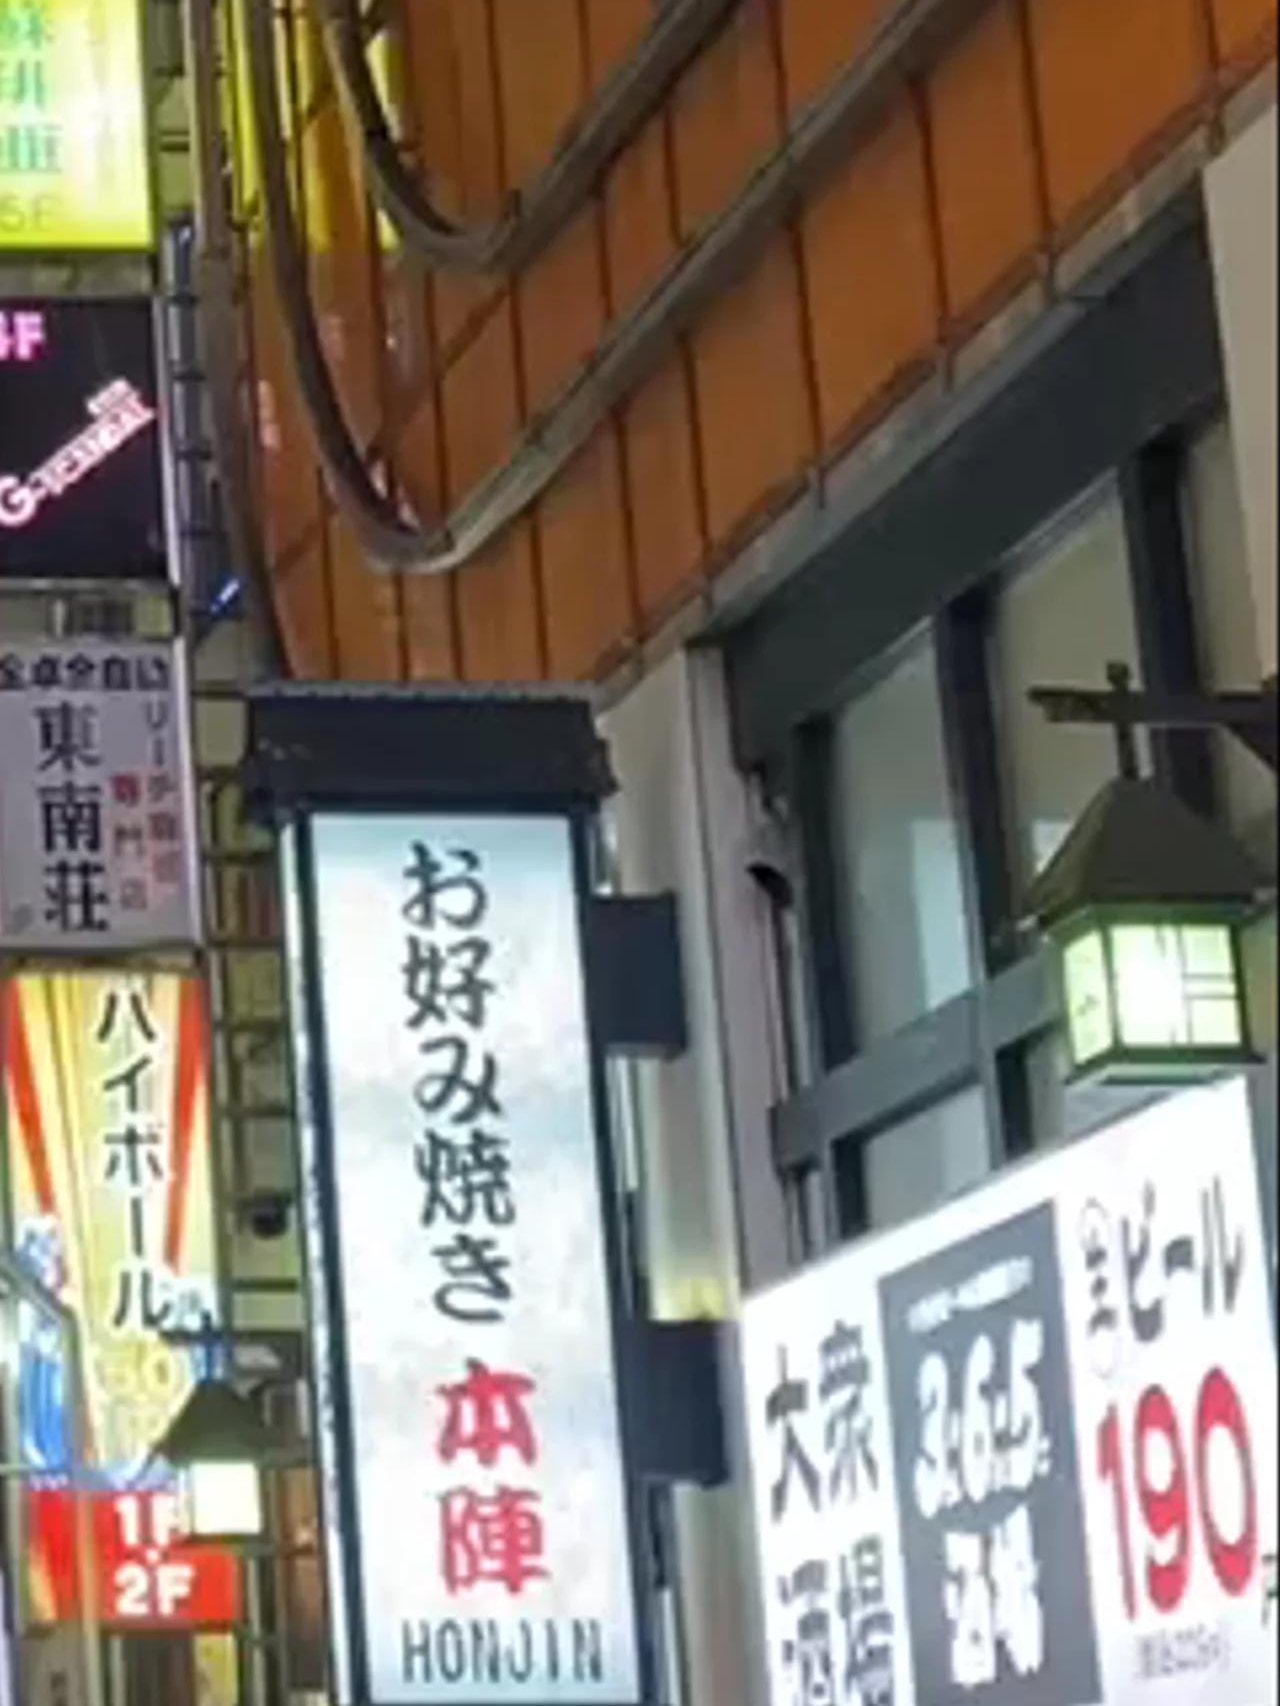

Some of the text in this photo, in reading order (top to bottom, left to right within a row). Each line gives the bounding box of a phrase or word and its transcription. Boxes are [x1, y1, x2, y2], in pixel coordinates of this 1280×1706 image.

[32, 699, 111, 934] 東南荘
[96, 990, 172, 1330] ハイボール
[401, 840, 516, 1324] お好み焼き
[114, 1563, 195, 1617] 2F
[434, 1357, 552, 1596] 本陣
[1096, 1364, 1260, 1623] 190
[401, 1614, 604, 1688] HONJIN
